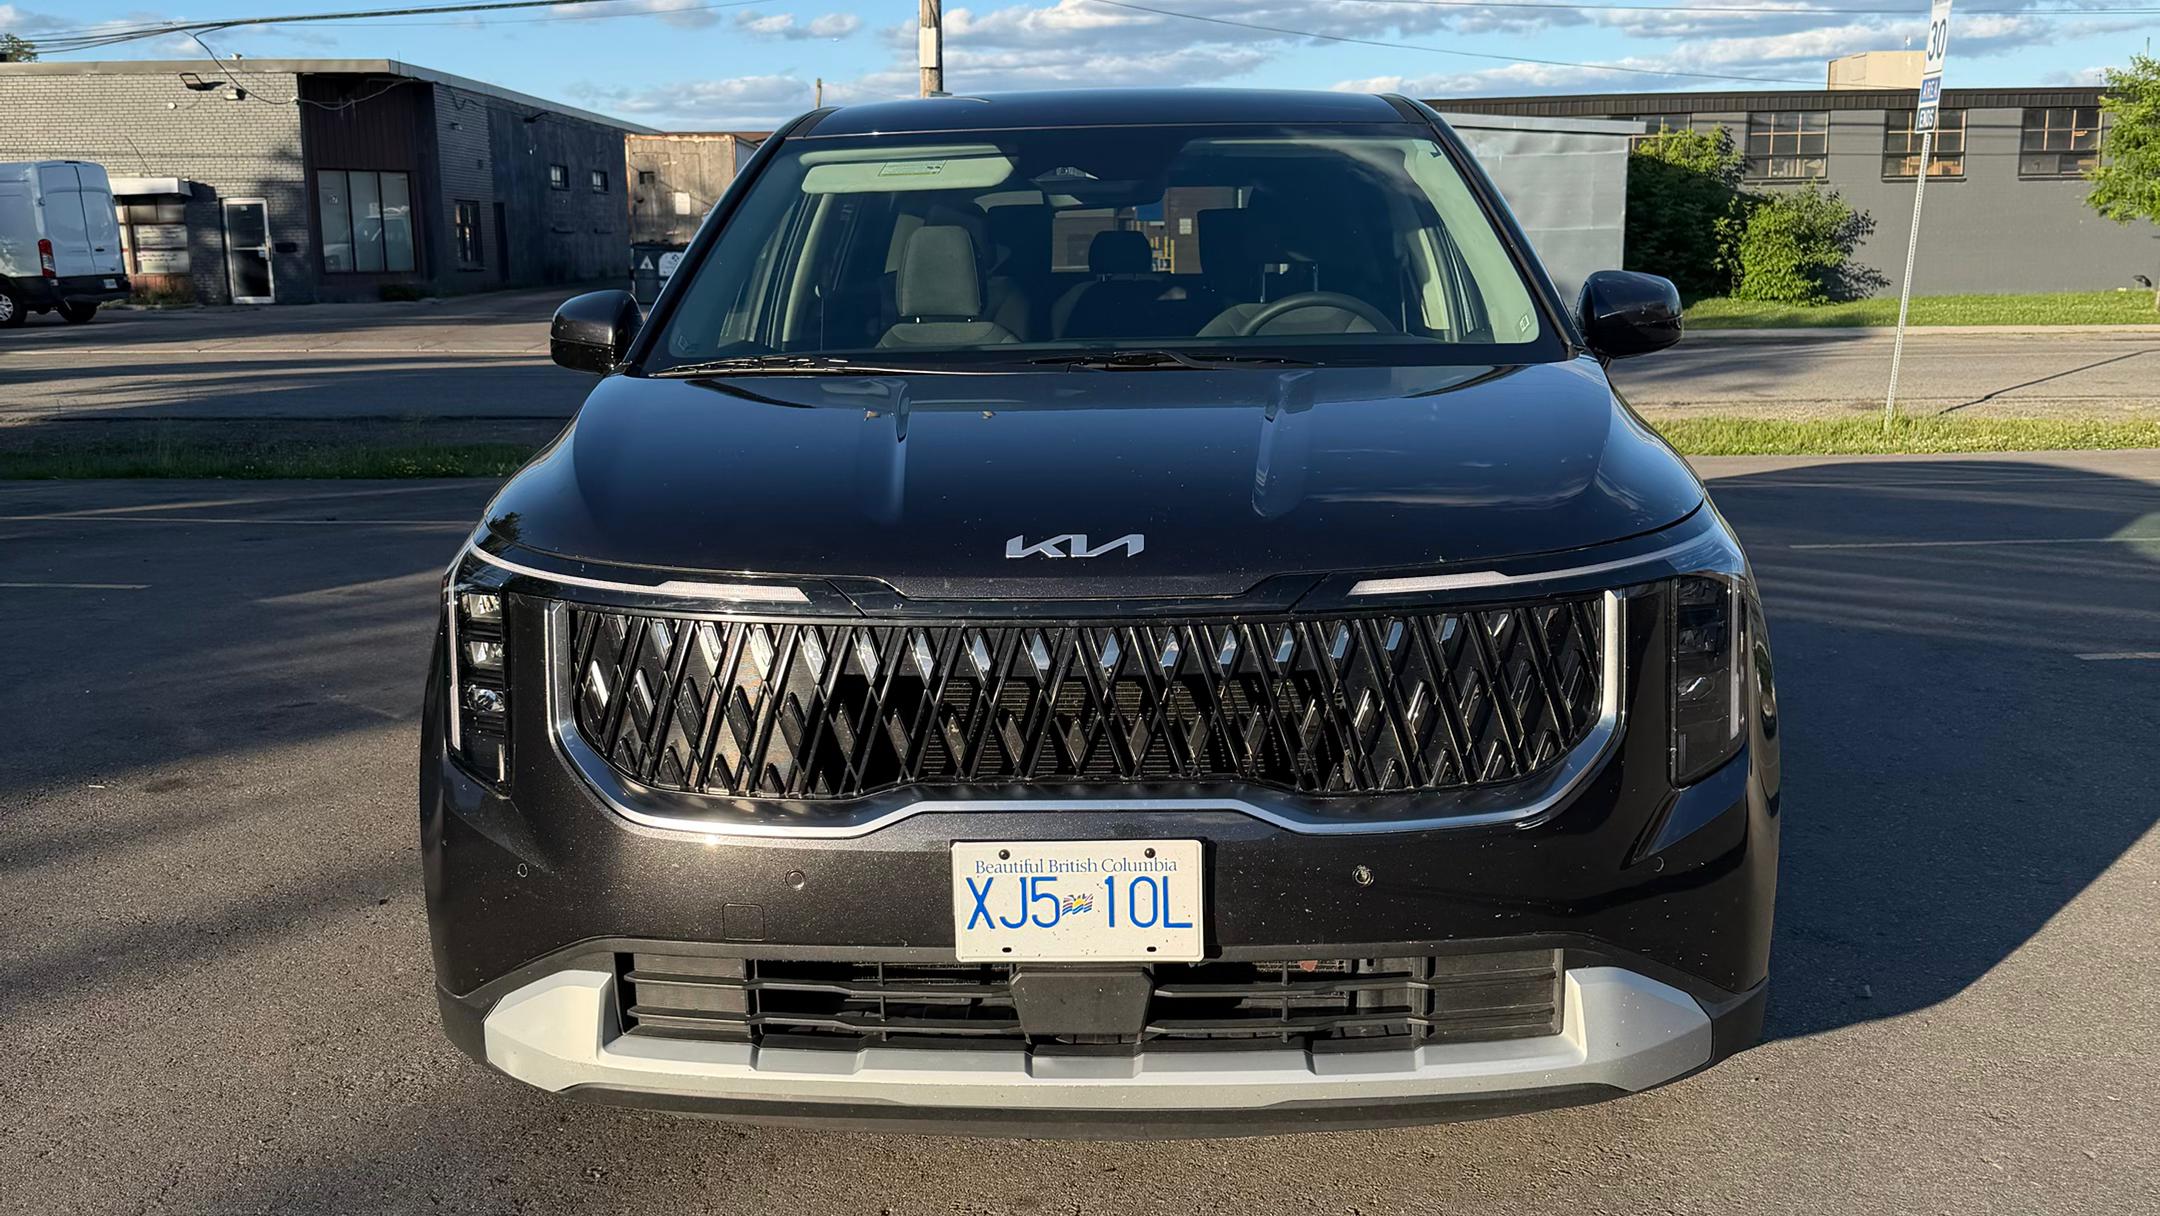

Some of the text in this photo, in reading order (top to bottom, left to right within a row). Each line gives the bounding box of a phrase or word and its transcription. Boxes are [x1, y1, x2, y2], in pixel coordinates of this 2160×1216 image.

[1928, 18, 1947, 61] 30
[1006, 534, 1144, 558] KIA
[975, 857, 1178, 874] Beautiful British Columbia
[966, 876, 1193, 930] XJ5 10L
